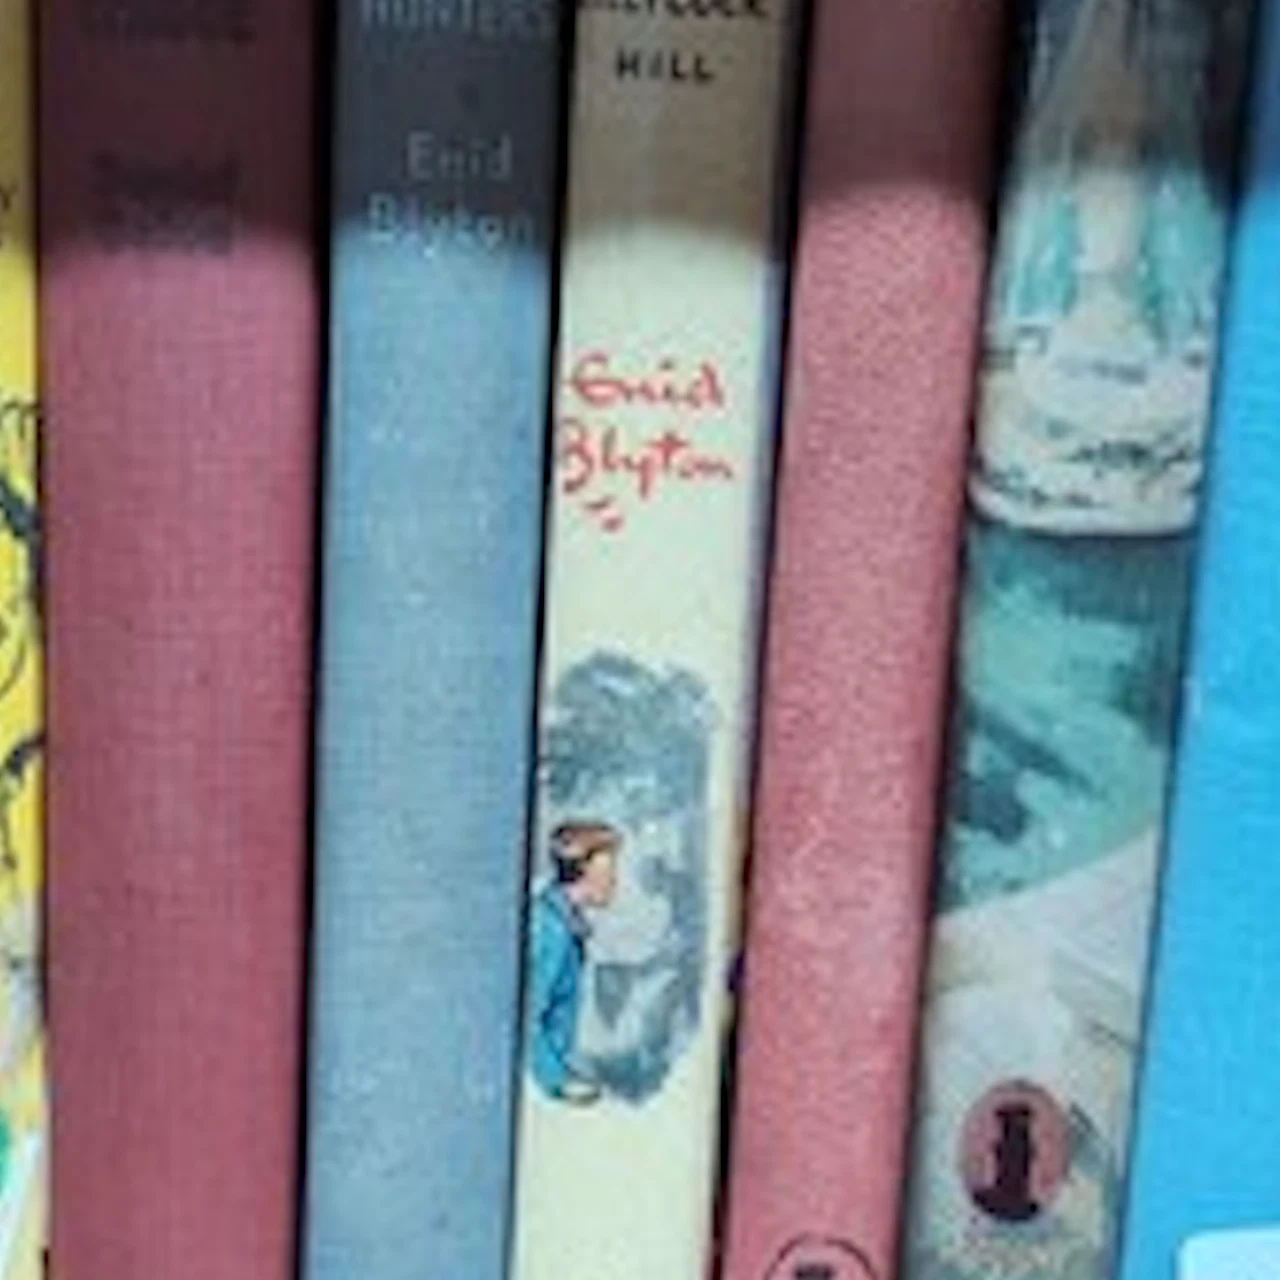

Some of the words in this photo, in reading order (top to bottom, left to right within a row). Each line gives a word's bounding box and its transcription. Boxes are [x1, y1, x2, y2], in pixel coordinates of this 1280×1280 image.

[616, 50, 714, 83] HILL
[406, 129, 514, 183] Enid
[366, 192, 540, 262] Blyton
[568, 350, 724, 410] Enid
[562, 417, 734, 502] Blyton
